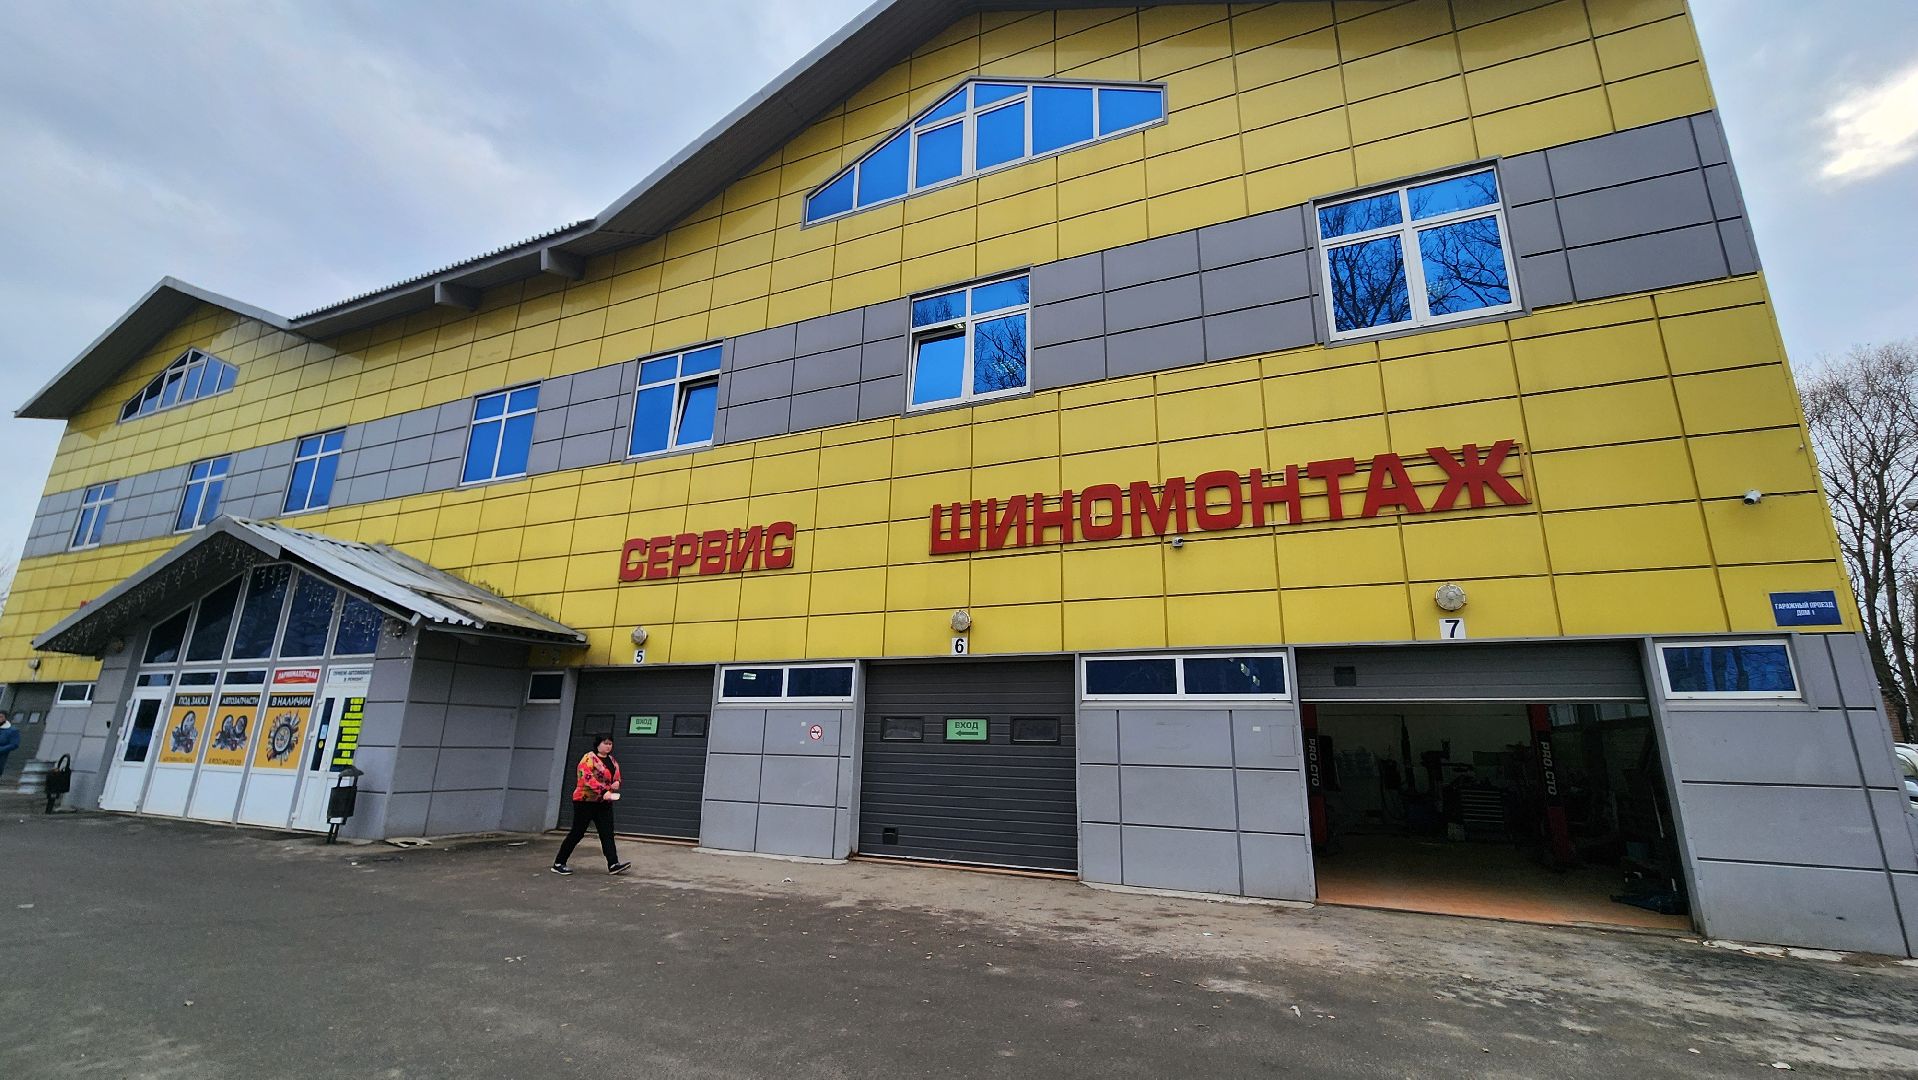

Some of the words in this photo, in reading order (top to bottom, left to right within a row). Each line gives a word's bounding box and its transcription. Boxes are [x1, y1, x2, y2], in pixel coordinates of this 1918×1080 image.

[930, 440, 1529, 555] ШИНОМОНТАЖ
[619, 521, 795, 582] СЕРВИС
[1445, 619, 1460, 638] 7
[954, 639, 964, 653] 6
[636, 650, 644, 663] 5
[178, 697, 191, 705] ПОД
[191, 696, 209, 704] ЗАКАЗ
[222, 696, 259, 704] АВТОЗАПЧАСТИ
[272, 697, 277, 706] В
[277, 696, 311, 706] НАЛИЧИИ
[954, 721, 979, 729] ВХОД
